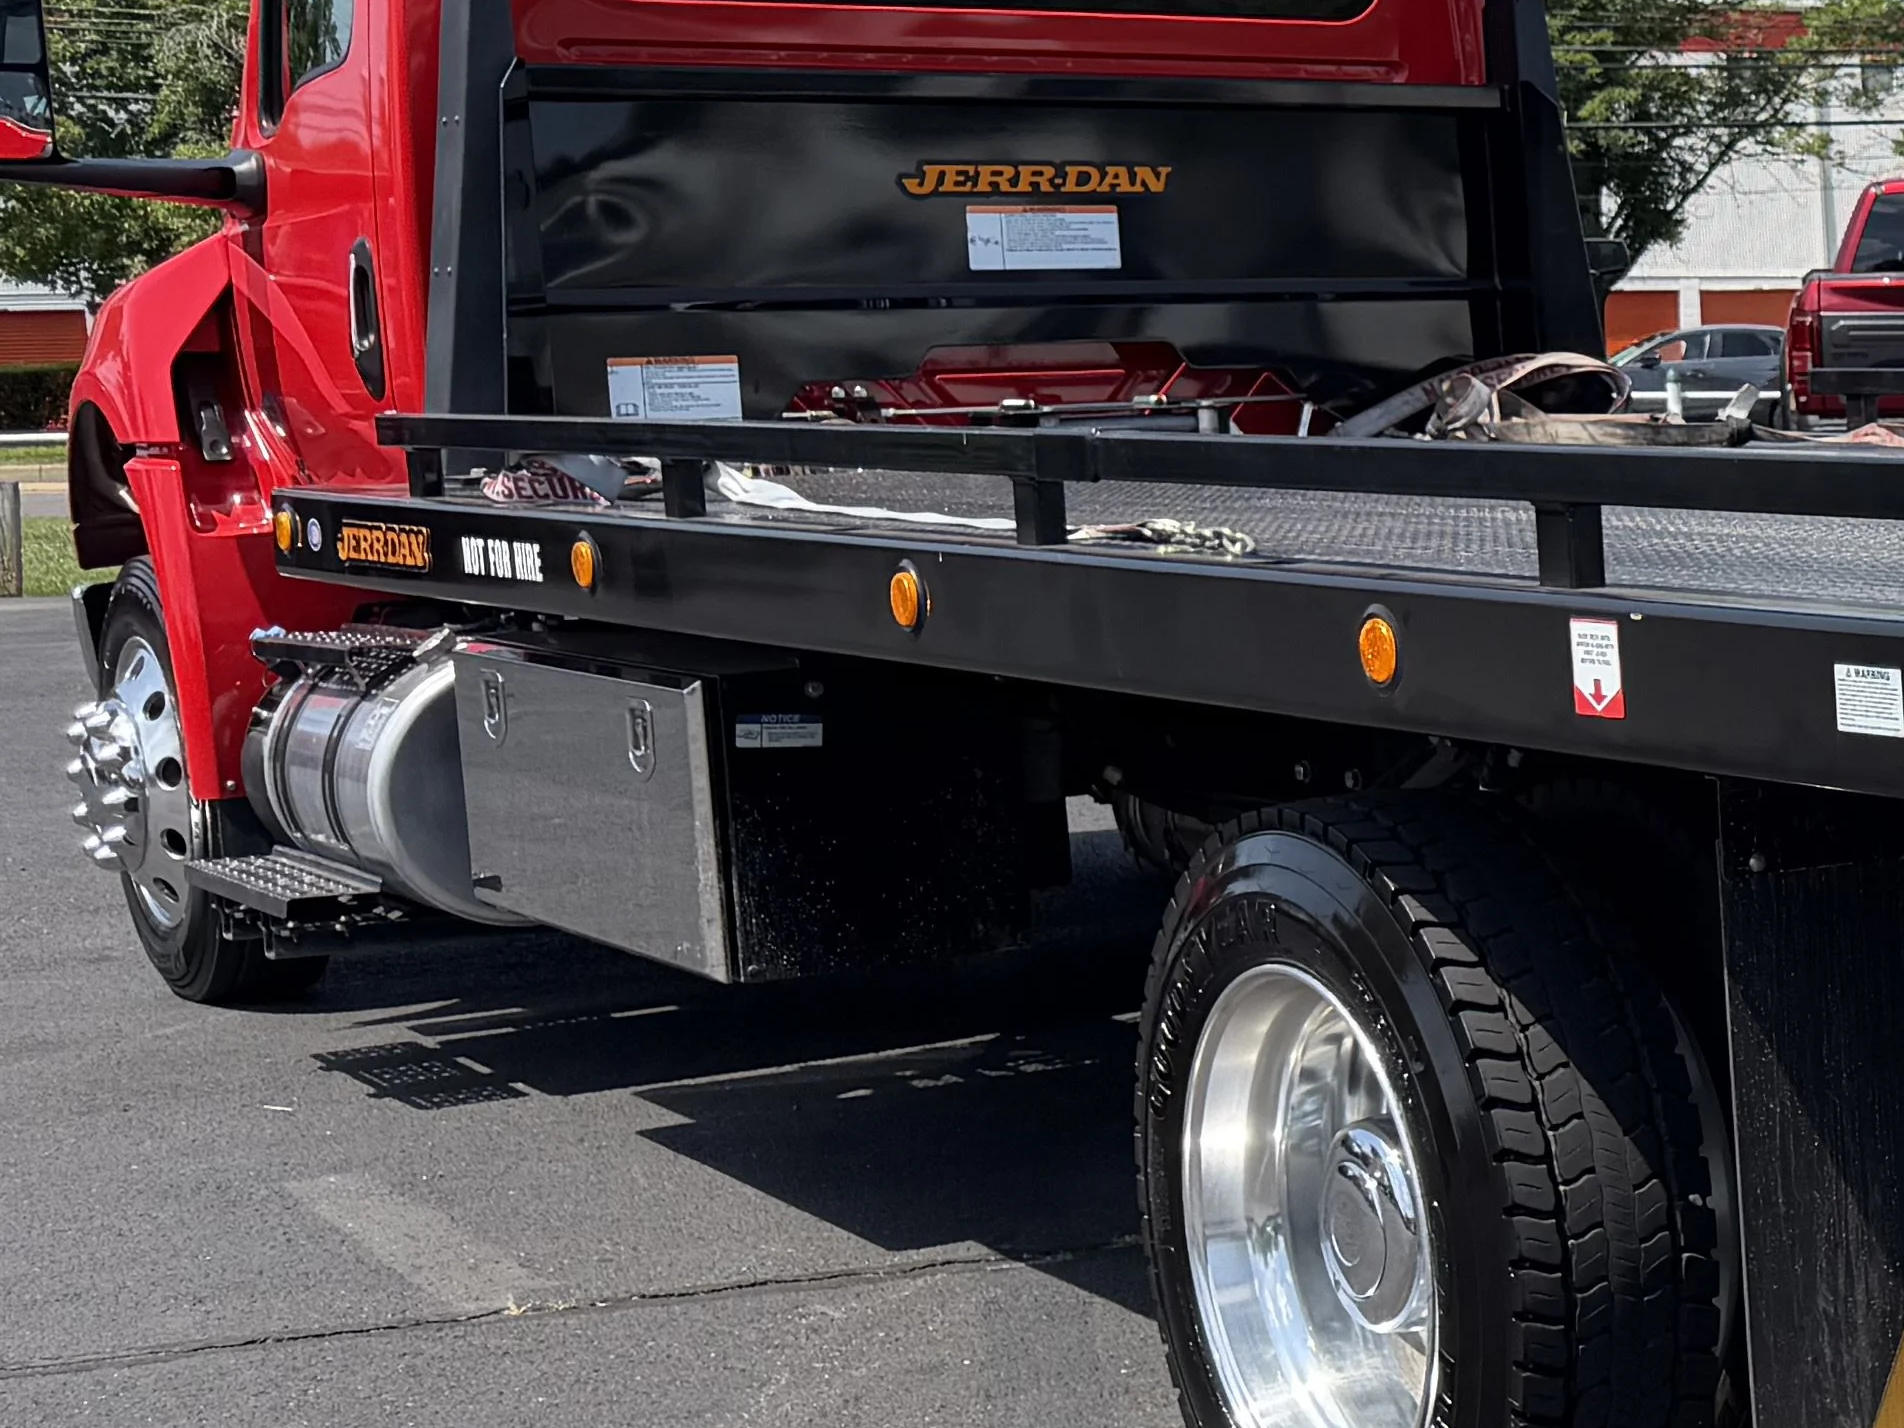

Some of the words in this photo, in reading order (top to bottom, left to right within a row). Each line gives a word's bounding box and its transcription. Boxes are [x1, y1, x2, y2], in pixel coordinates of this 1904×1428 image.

[901, 164, 1172, 194] JERR-DAN
[501, 473, 600, 501] SECUR
[461, 536, 486, 576] NOT
[487, 538, 512, 579] FOR
[513, 540, 544, 582] HIRE
[761, 714, 800, 723] NOTICE
